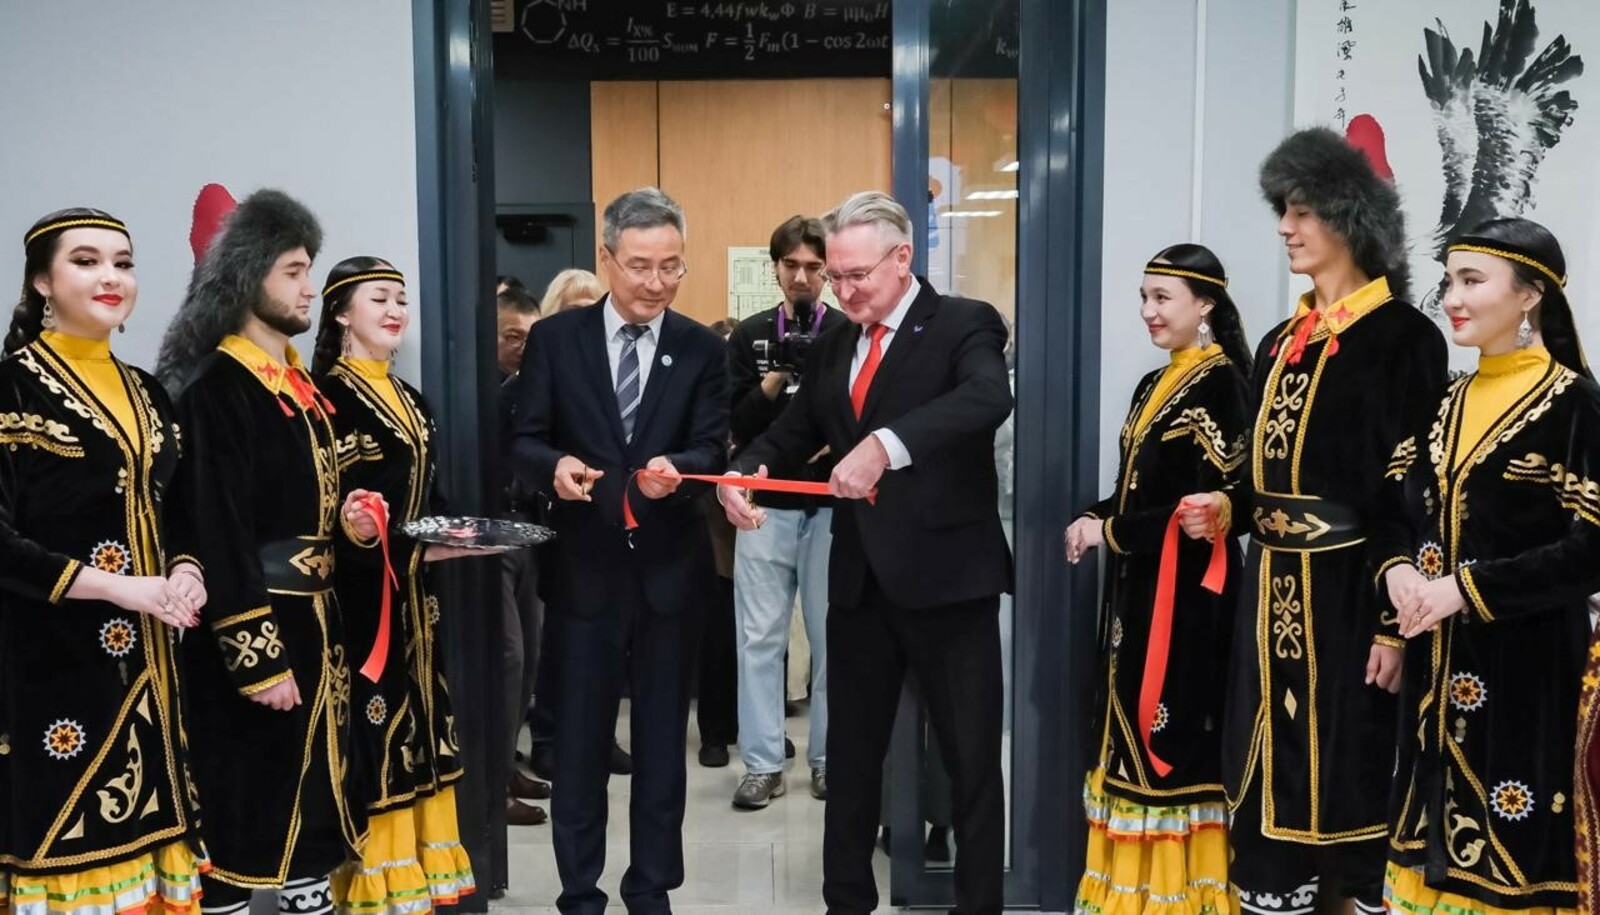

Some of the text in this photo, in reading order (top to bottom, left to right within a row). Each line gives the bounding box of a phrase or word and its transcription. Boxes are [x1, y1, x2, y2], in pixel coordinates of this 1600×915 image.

[666, 3, 677, 18] E
[804, 2, 817, 19] B
[705, 32, 718, 49] F
[823, 36, 852, 49] cos
[629, 47, 660, 62] 100
